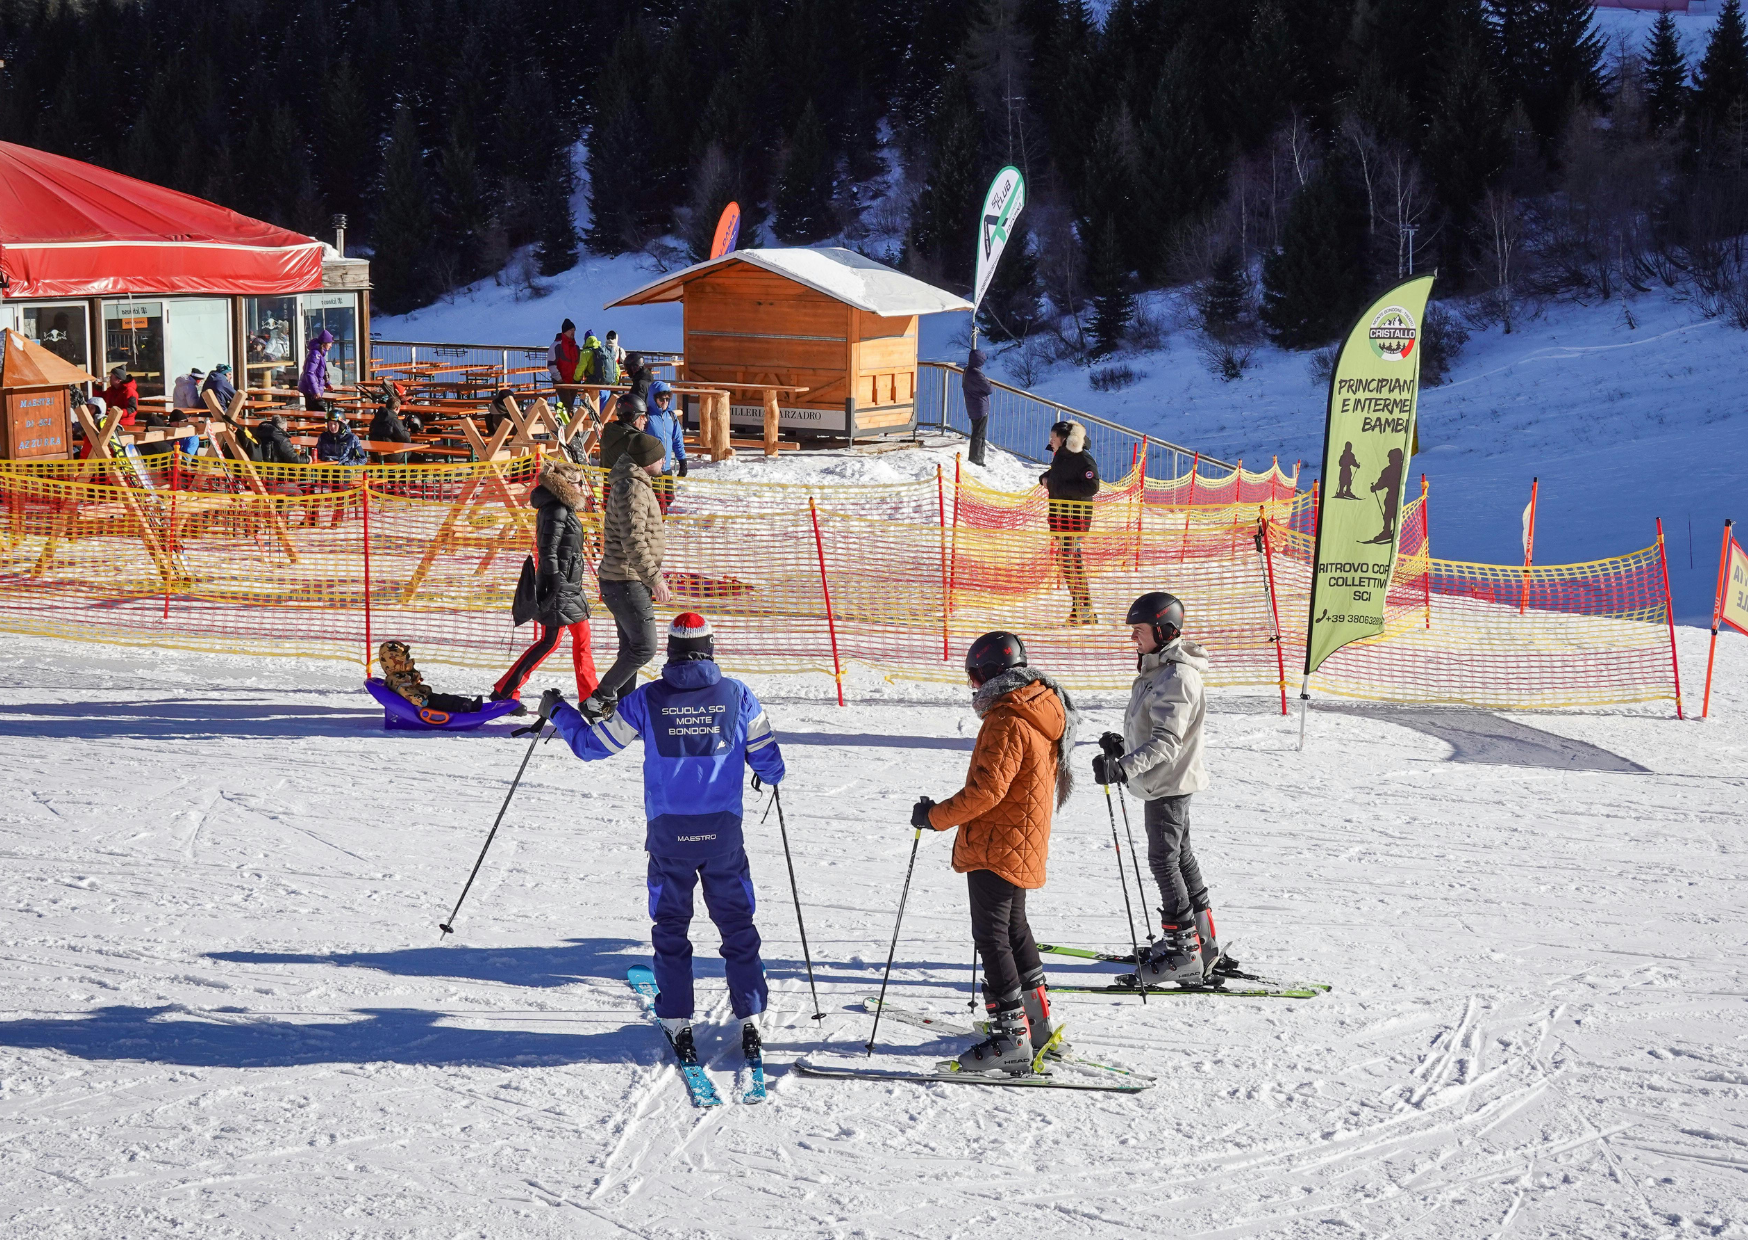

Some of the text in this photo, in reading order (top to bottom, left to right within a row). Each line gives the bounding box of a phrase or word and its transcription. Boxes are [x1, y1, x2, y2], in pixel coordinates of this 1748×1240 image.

[996, 179, 1012, 210] CLUB
[1370, 329, 1416, 339] CRISTALLO
[1338, 378, 1414, 395] PRINCIPIAN
[20, 396, 55, 408] MAESTRI
[1341, 397, 1410, 415] E INTERME
[778, 411, 822, 421] ARZADRO
[26, 418, 52, 428] DI SCI
[1361, 416, 1409, 434] BAMBI
[18, 437, 61, 450] AZZURRA
[1319, 562, 1390, 575] RITROVO COR
[1353, 590, 1372, 602] SCI
[1326, 614, 1345, 623] +39
[661, 705, 726, 715] SCUOLA SCI
[676, 716, 713, 725] MONTE
[668, 726, 721, 736] BONDONE
[677, 833, 717, 842] MAESTRO
[1178, 971, 1201, 979] HEAD
